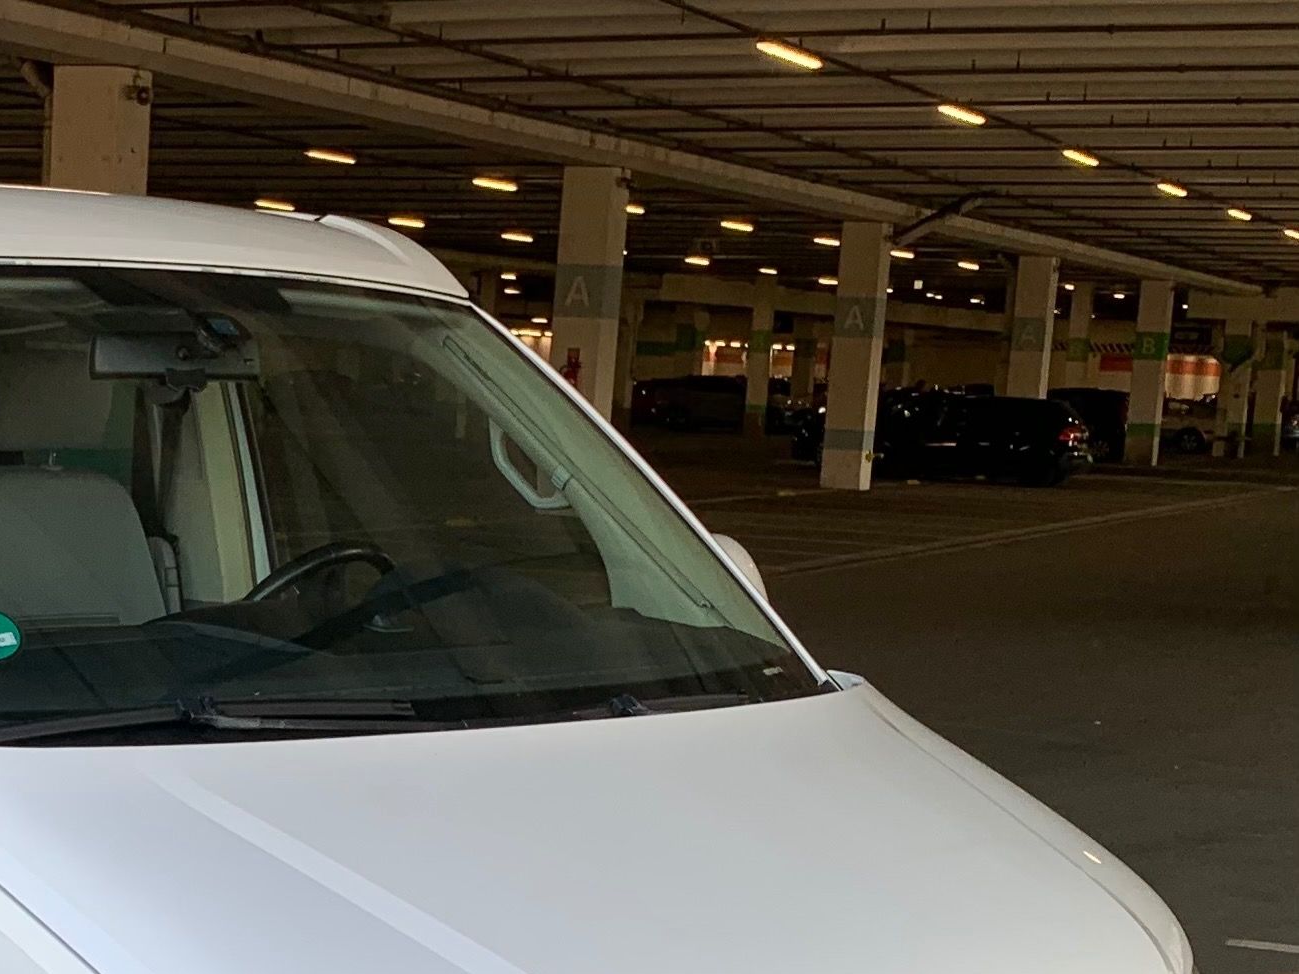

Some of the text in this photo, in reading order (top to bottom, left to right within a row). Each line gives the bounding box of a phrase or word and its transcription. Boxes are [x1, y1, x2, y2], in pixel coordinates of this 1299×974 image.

[564, 275, 590, 306] A
[843, 304, 864, 330] A
[1142, 337, 1156, 354] B
